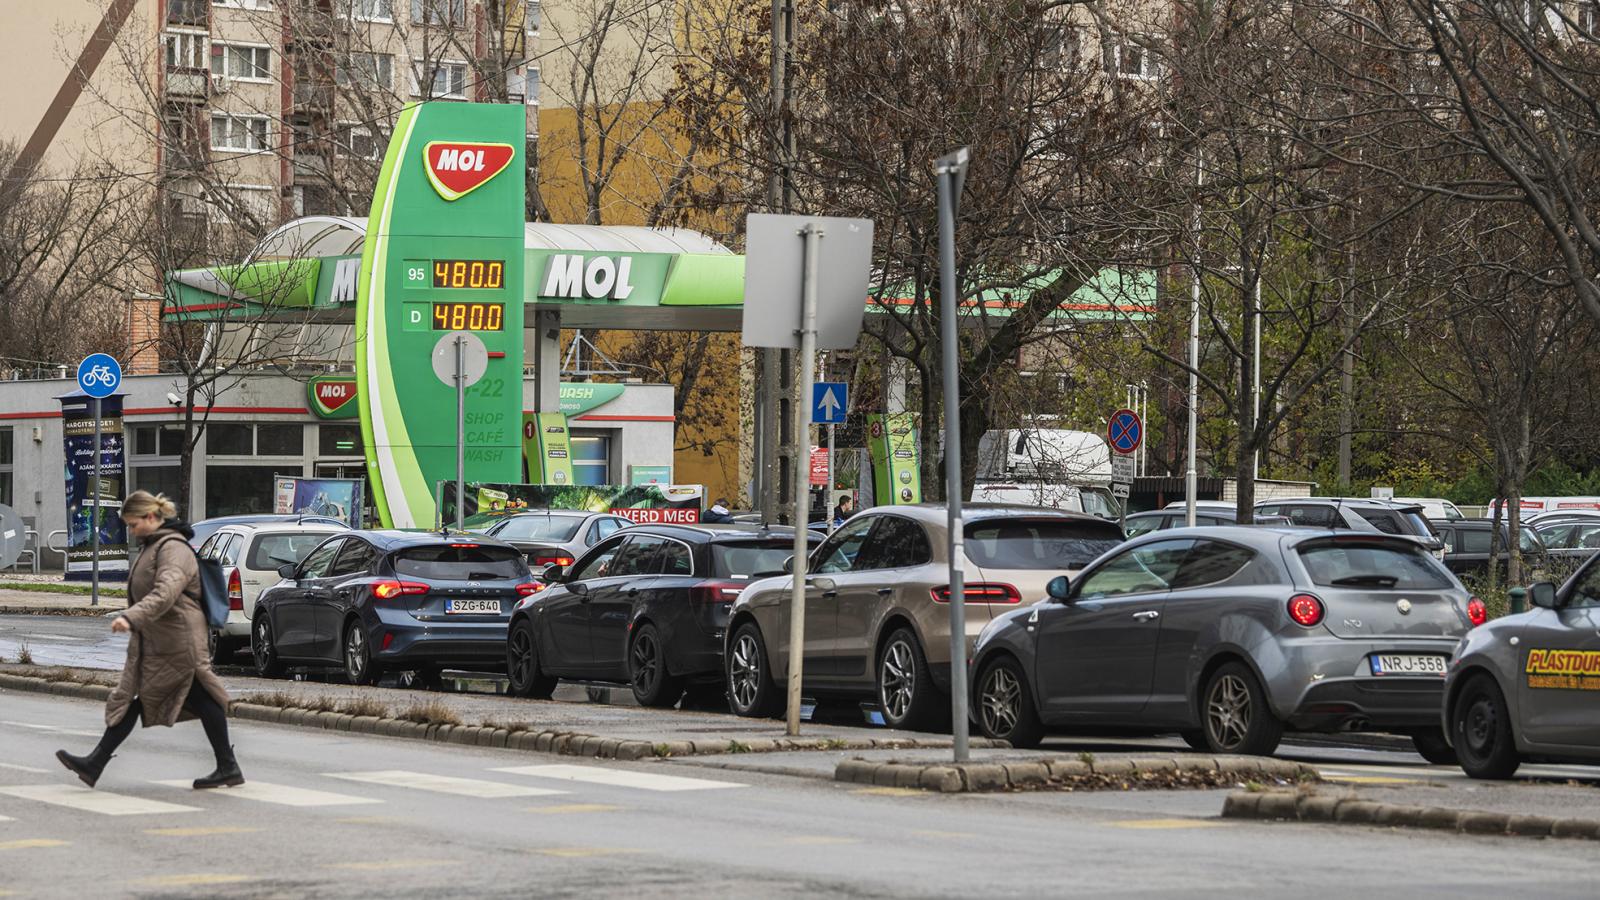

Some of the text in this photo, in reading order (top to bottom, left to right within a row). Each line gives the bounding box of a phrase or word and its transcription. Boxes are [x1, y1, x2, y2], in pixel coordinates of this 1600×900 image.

[436, 149, 486, 172] MOL
[408, 262, 502, 289] 95 480.0
[541, 254, 634, 300] MOL
[411, 305, 502, 331] D 480.0
[320, 385, 346, 398] MOL
[463, 378, 505, 397] -22
[465, 413, 505, 425] SHOP
[467, 428, 505, 443] CAFÉ
[527, 423, 532, 437] 1
[873, 423, 880, 437] 3
[664, 510, 696, 523] MEG
[453, 601, 499, 612] SZG-640
[1382, 656, 1443, 672] NRJ-558
